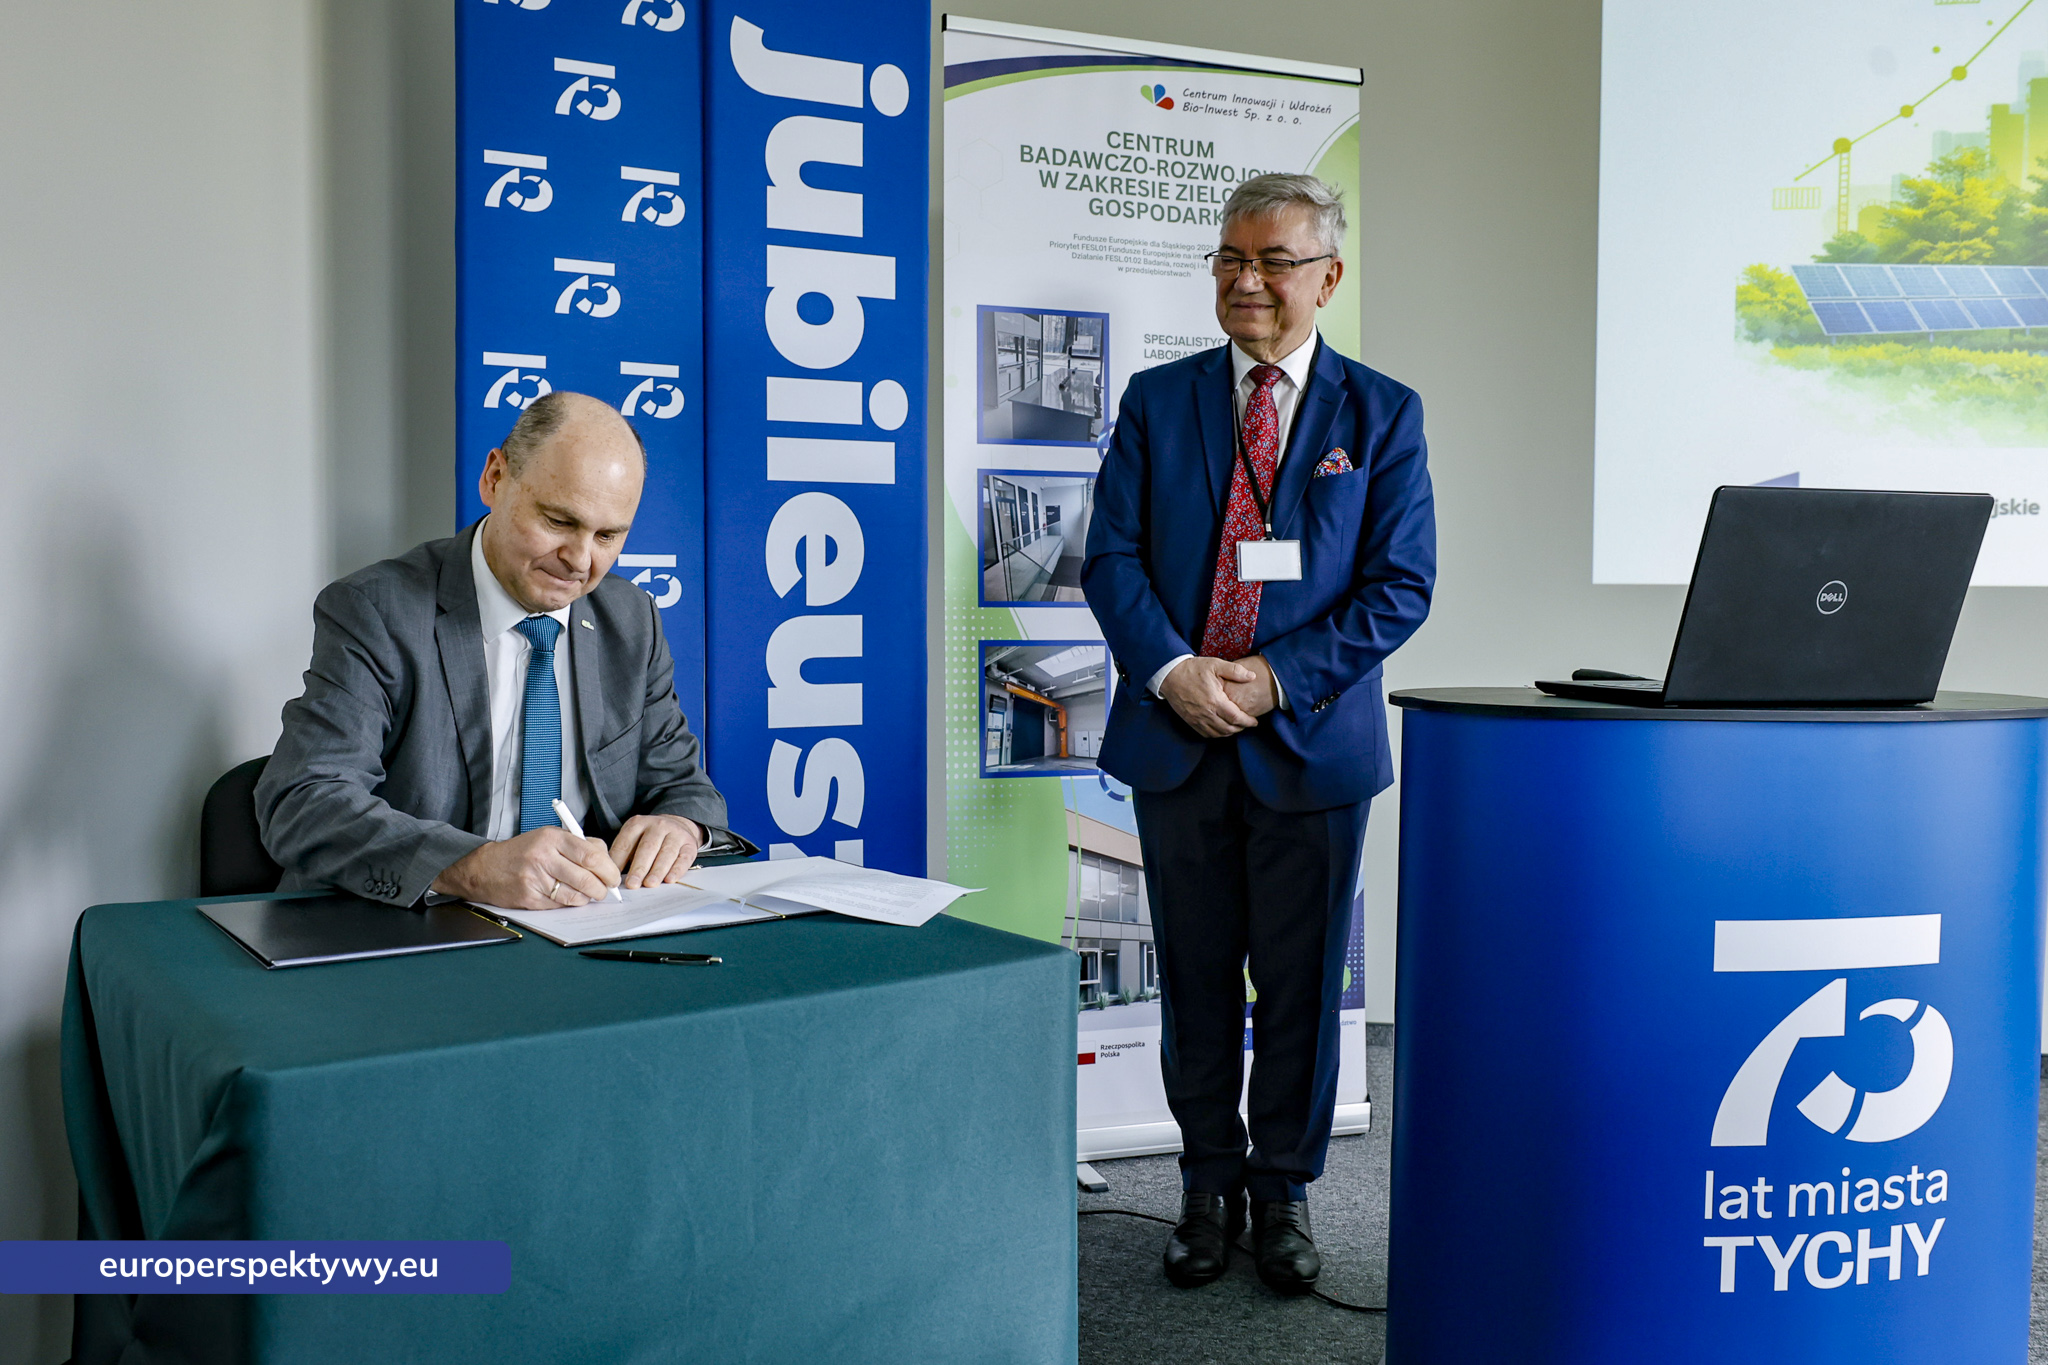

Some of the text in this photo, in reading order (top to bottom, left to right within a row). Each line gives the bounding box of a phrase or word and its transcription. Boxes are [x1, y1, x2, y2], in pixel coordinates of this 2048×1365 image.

[1183, 88, 1332, 115] Centrum Innowacji i Wdrożeń
[1183, 102, 1238, 117] Bio-Inwest
[1244, 108, 1260, 121] Sp.
[1278, 115, 1287, 124] o.
[1293, 117, 1302, 125] o.
[1107, 131, 1214, 158] CENTRUM
[1039, 169, 1059, 189] W
[1065, 172, 1170, 200] ZAKRESIE
[1089, 198, 1224, 226] GOSPODARK
[1049, 240, 1080, 251] Priorytet
[1108, 245, 1141, 255] Fundusze
[1143, 249, 1181, 260] Europejskie
[1073, 233, 1107, 243] Fundusze
[1109, 236, 1148, 247] Europejskie
[1150, 240, 1160, 248] dla
[1162, 240, 1195, 252] Śląskiego
[1072, 252, 1103, 261] Działanie
[1144, 258, 1171, 268] Badania,
[1173, 261, 1196, 271] rozwój
[1125, 266, 1191, 278] przedsiębiorstwach
[1144, 333, 1229, 348] SPECJALISTYC
[1991, 498, 2040, 518] jskie
[1100, 1041, 1145, 1050] Rzeczpospolita
[1704, 1165, 1948, 1220] lat miasta
[1703, 1217, 1946, 1293] TYCHY
